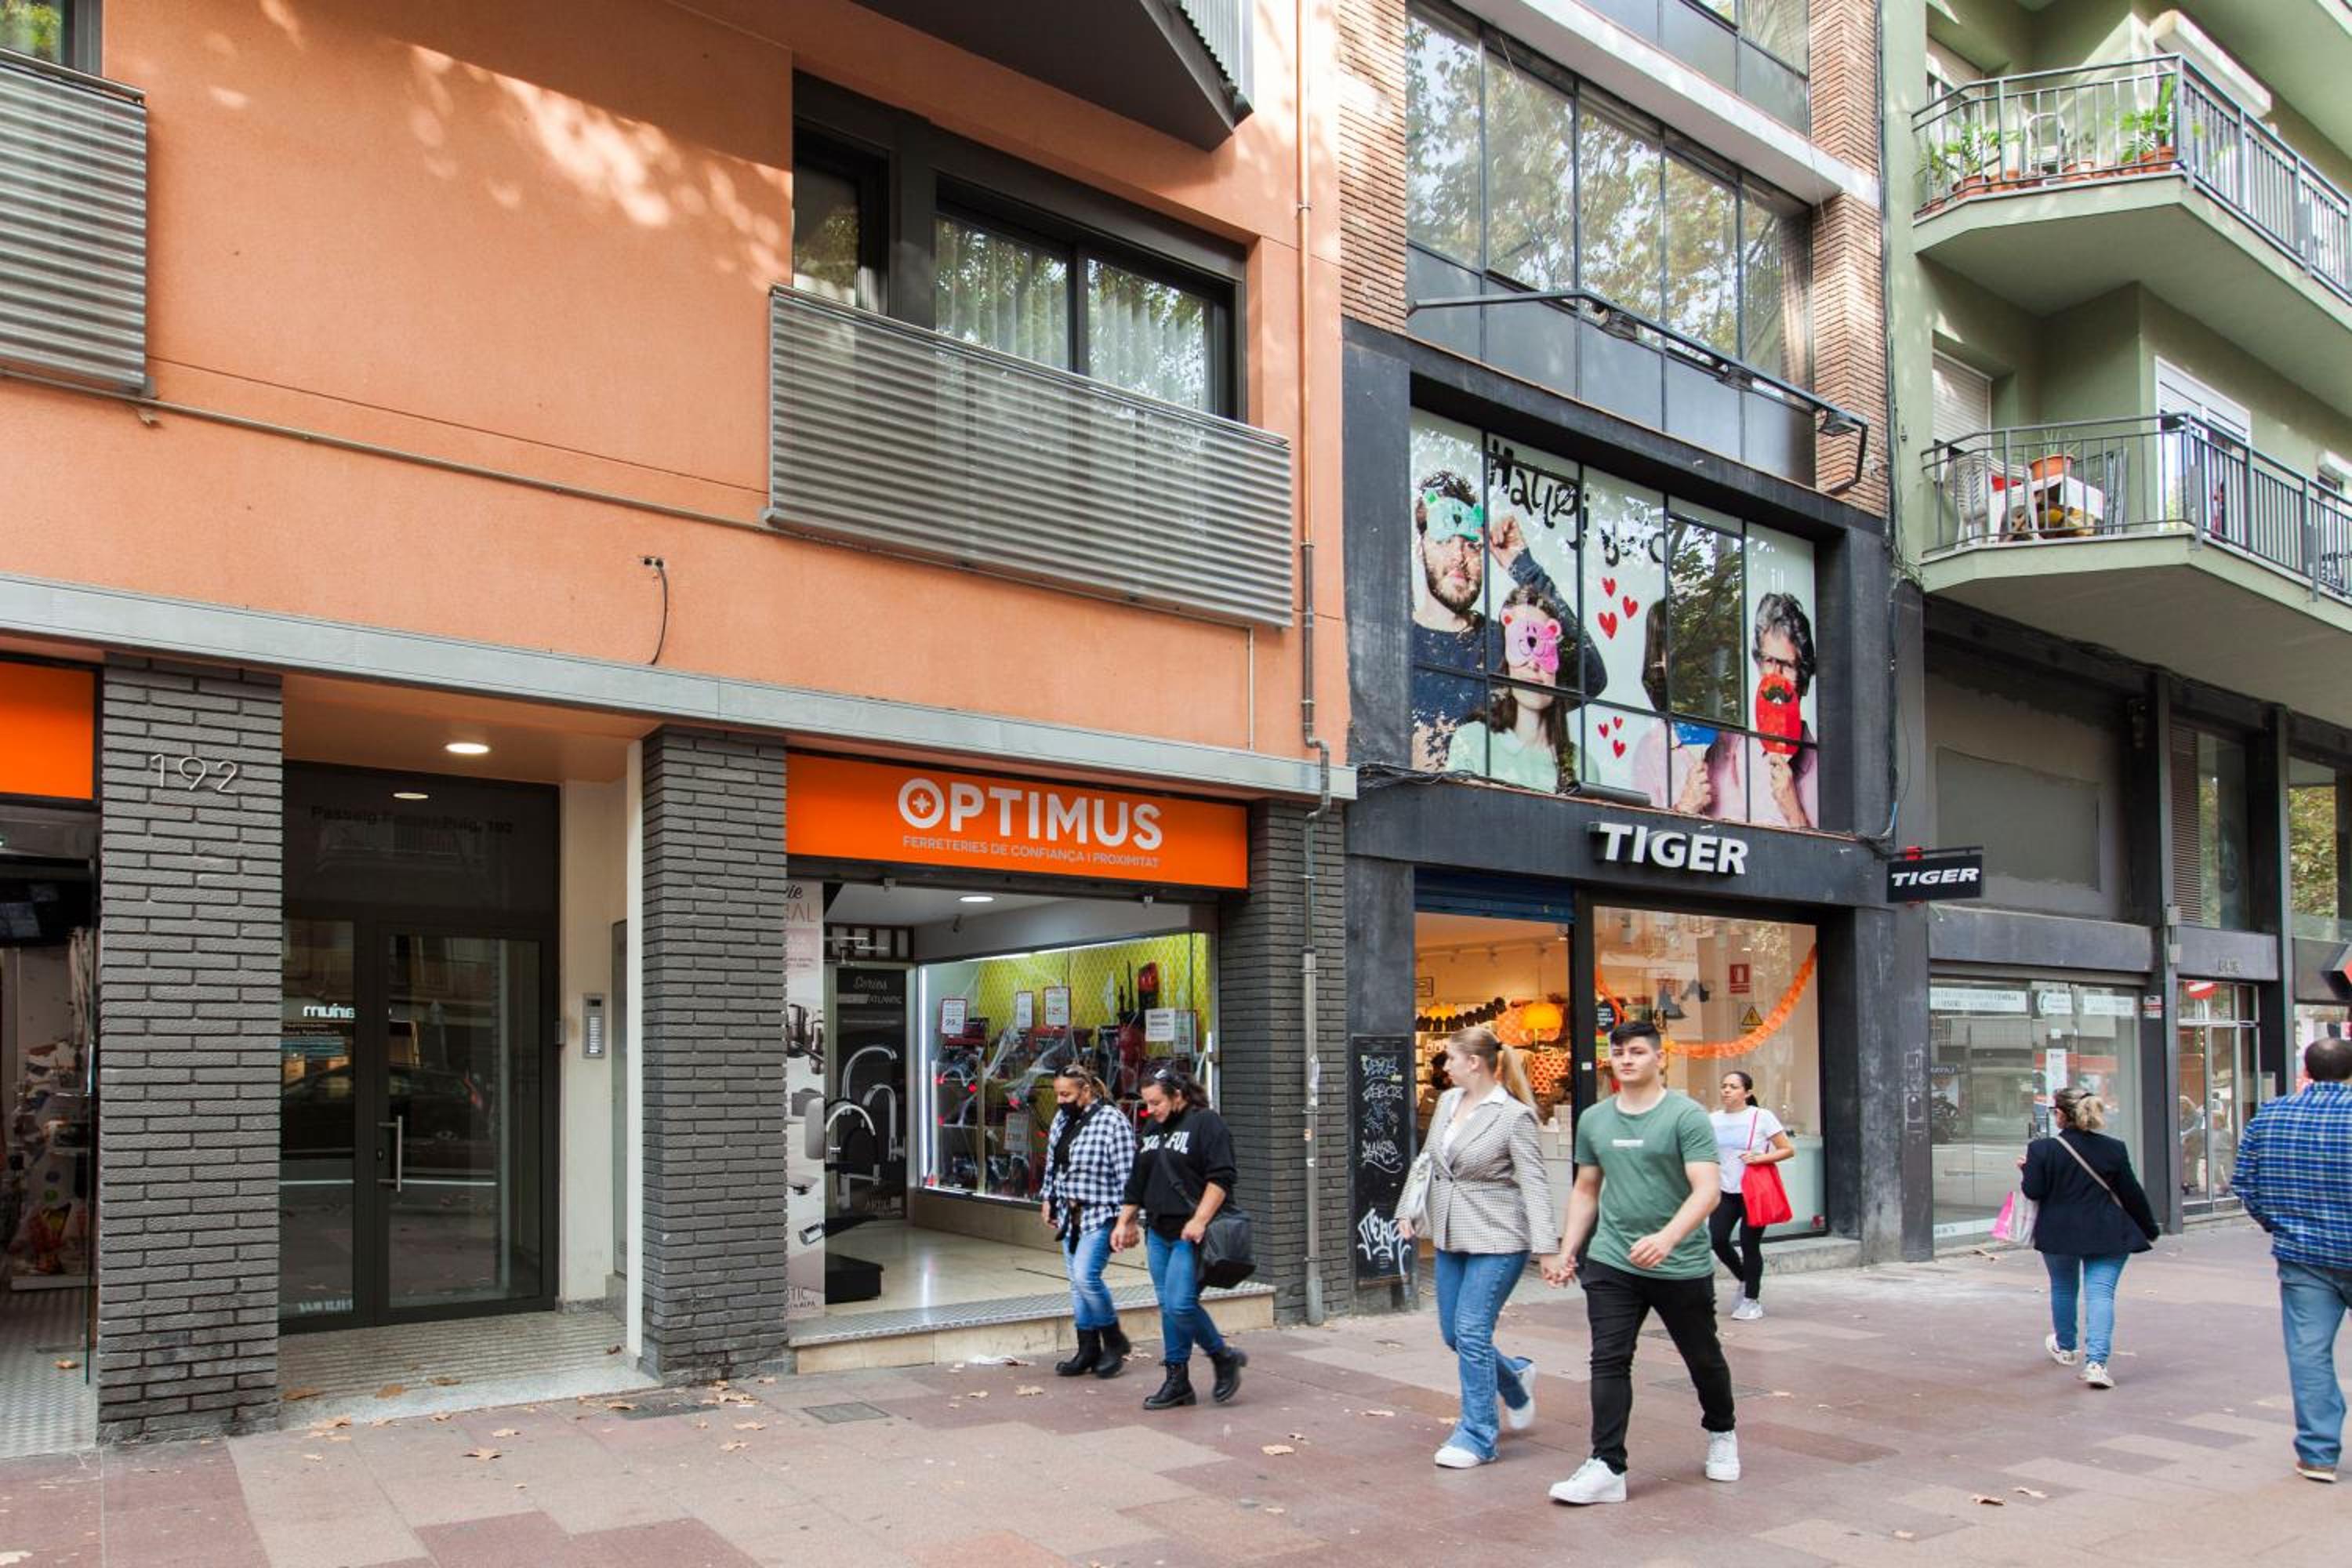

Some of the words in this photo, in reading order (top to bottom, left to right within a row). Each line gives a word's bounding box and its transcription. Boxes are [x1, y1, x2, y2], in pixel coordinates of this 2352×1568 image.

[151, 753, 238, 793] 192
[898, 777, 1163, 851] OPTIMUS
[903, 836, 987, 855] FERRETERIES
[991, 843, 1007, 855] DE
[1011, 844, 1084, 864] CONFIANÇA
[1094, 853, 1159, 868] PROXIMITAT
[1592, 822, 1749, 877] TIGER
[1891, 868, 1980, 887] TIGER
